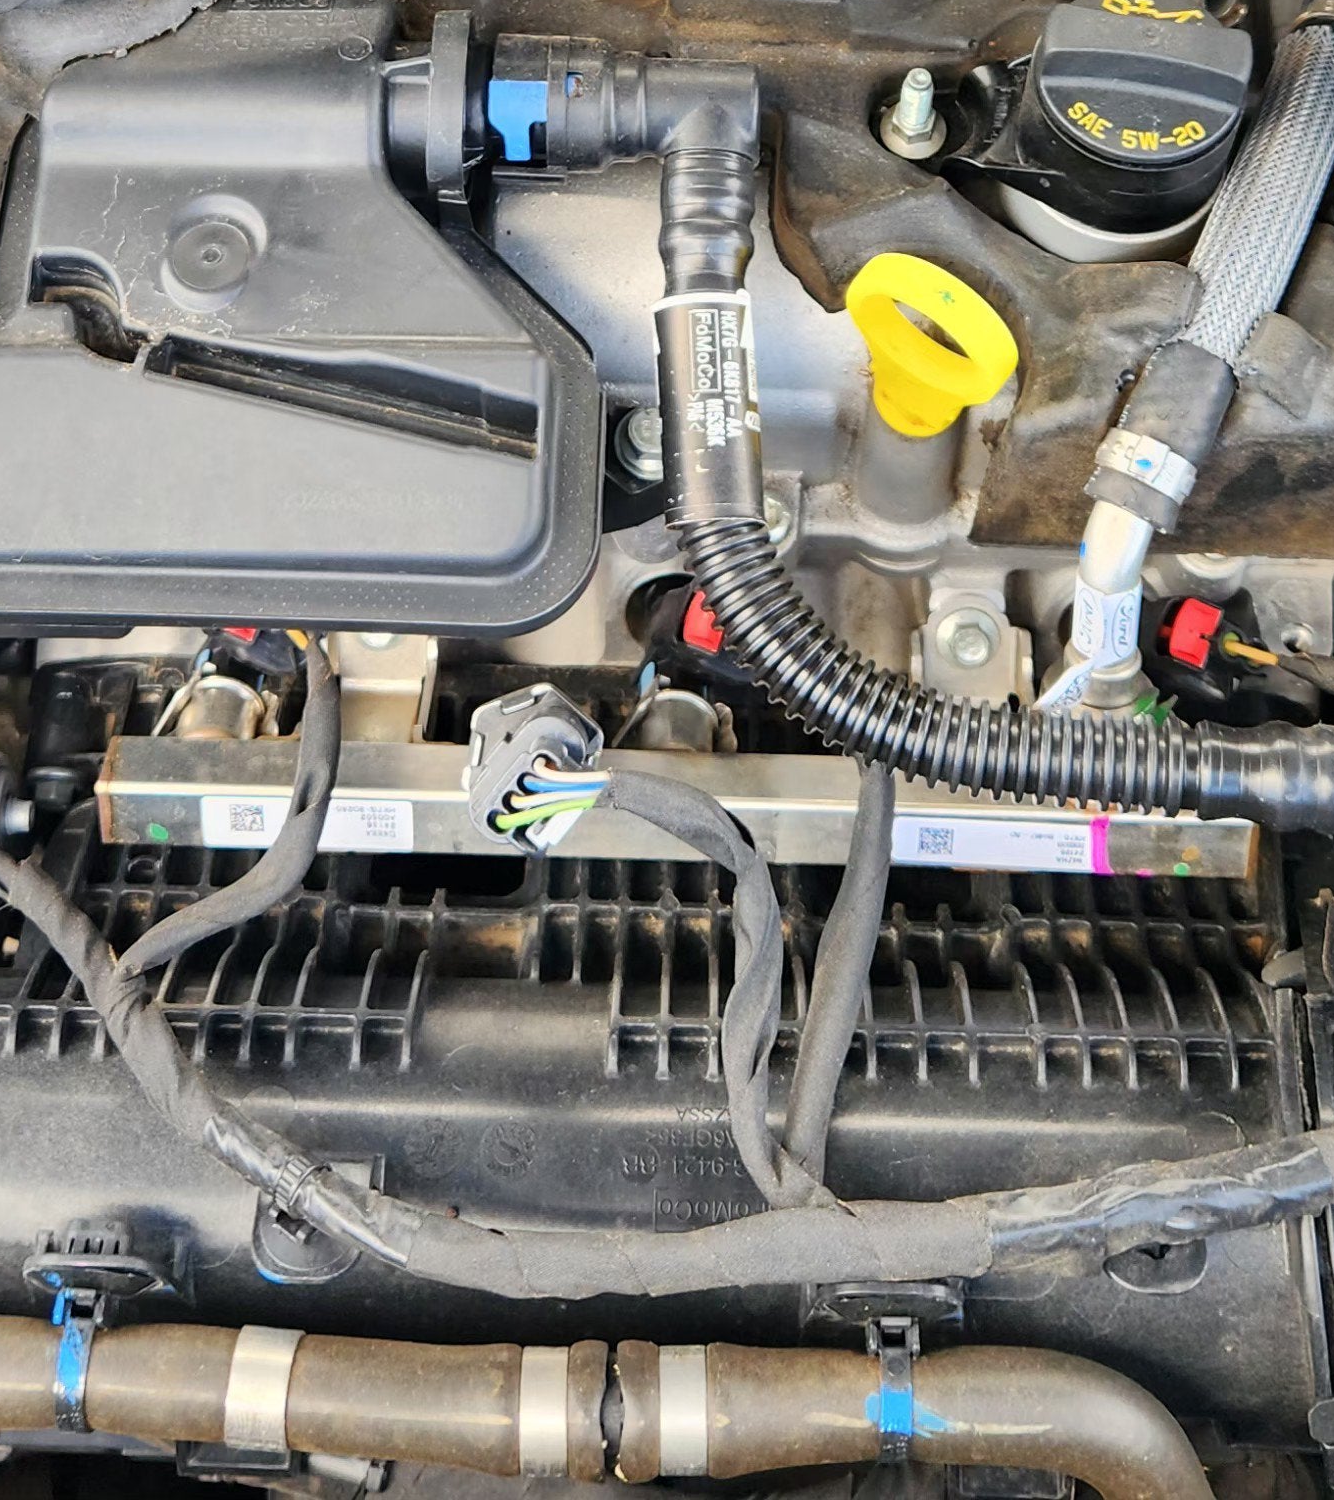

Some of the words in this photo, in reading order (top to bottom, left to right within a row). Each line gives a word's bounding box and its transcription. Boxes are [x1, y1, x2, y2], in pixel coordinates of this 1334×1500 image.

[1066, 100, 1113, 140] SAE
[1119, 119, 1207, 151] 5W-20
[695, 312, 712, 388] FoMoCo
